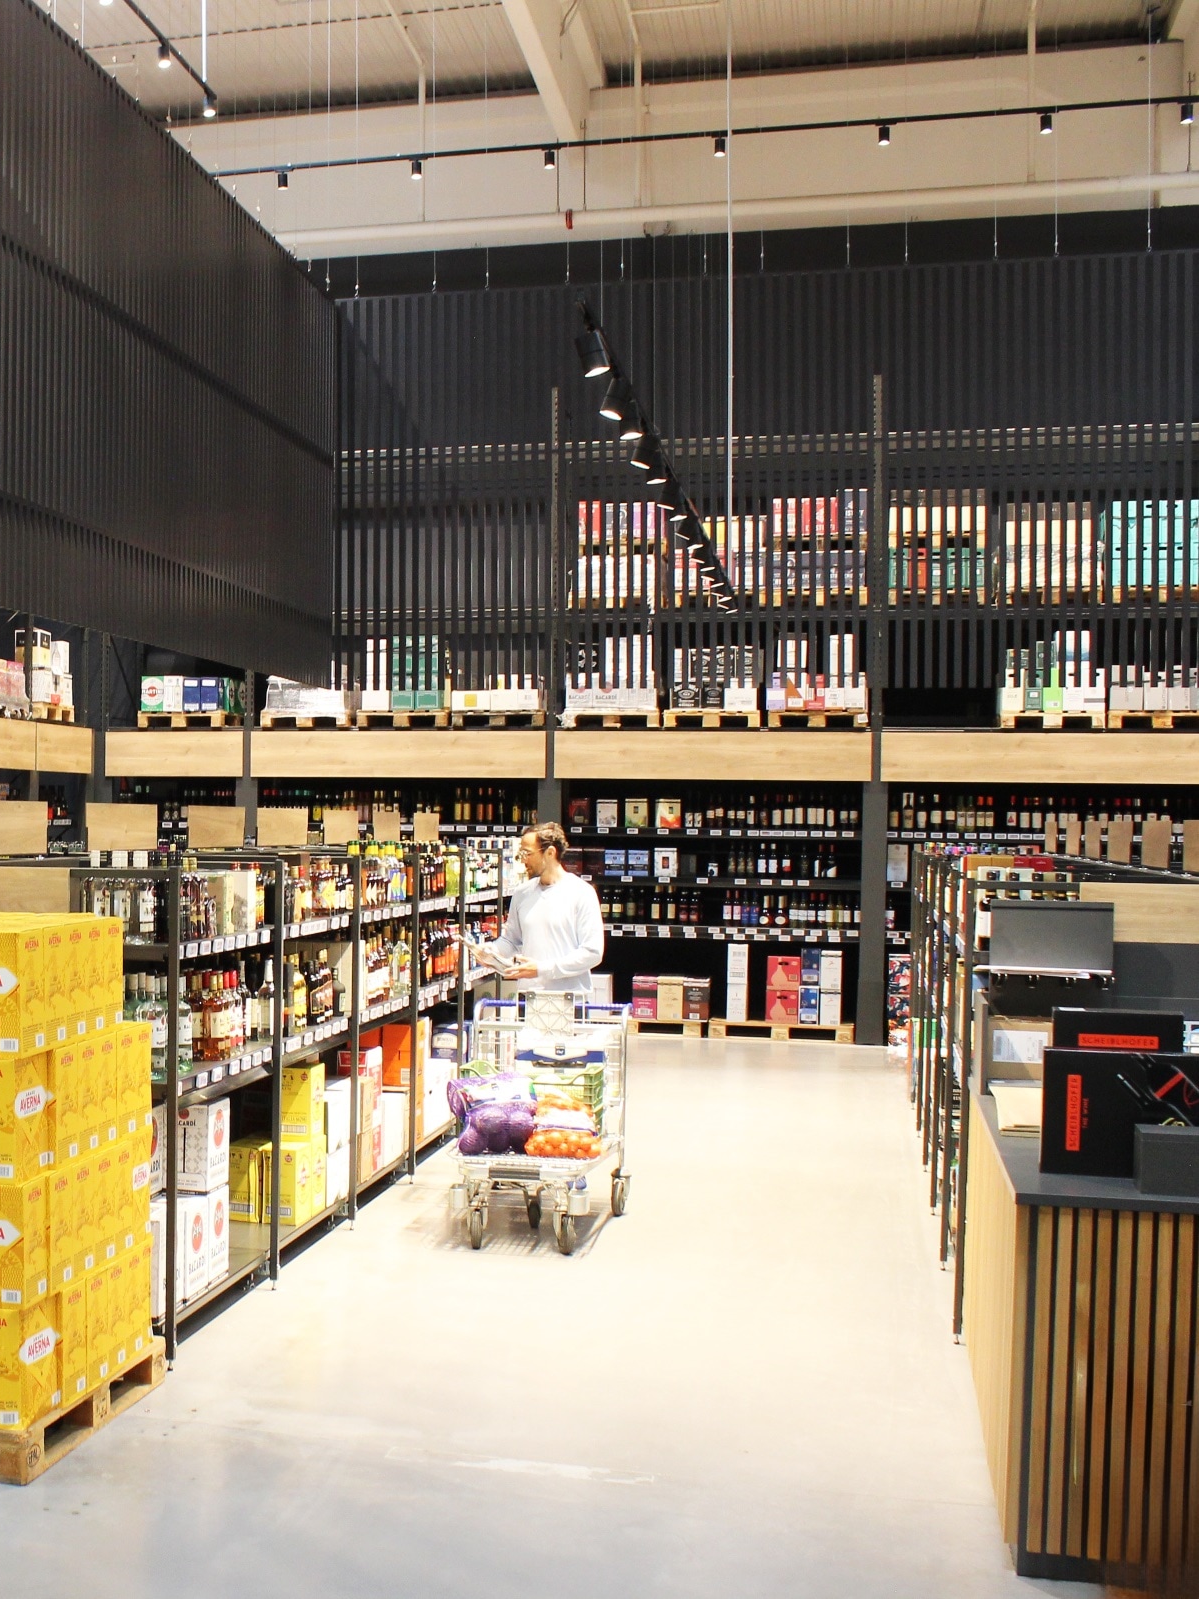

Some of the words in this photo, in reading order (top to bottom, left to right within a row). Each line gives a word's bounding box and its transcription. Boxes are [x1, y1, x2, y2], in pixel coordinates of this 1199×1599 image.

[1082, 1037, 1155, 1047] SCHEIBLHOFER
[19, 1093, 41, 1112] AVERNA
[1069, 1076, 1079, 1148] SCHEIBLHOFER
[178, 1119, 196, 1127] CARDÍ
[27, 1335, 51, 1359] AVERNA
